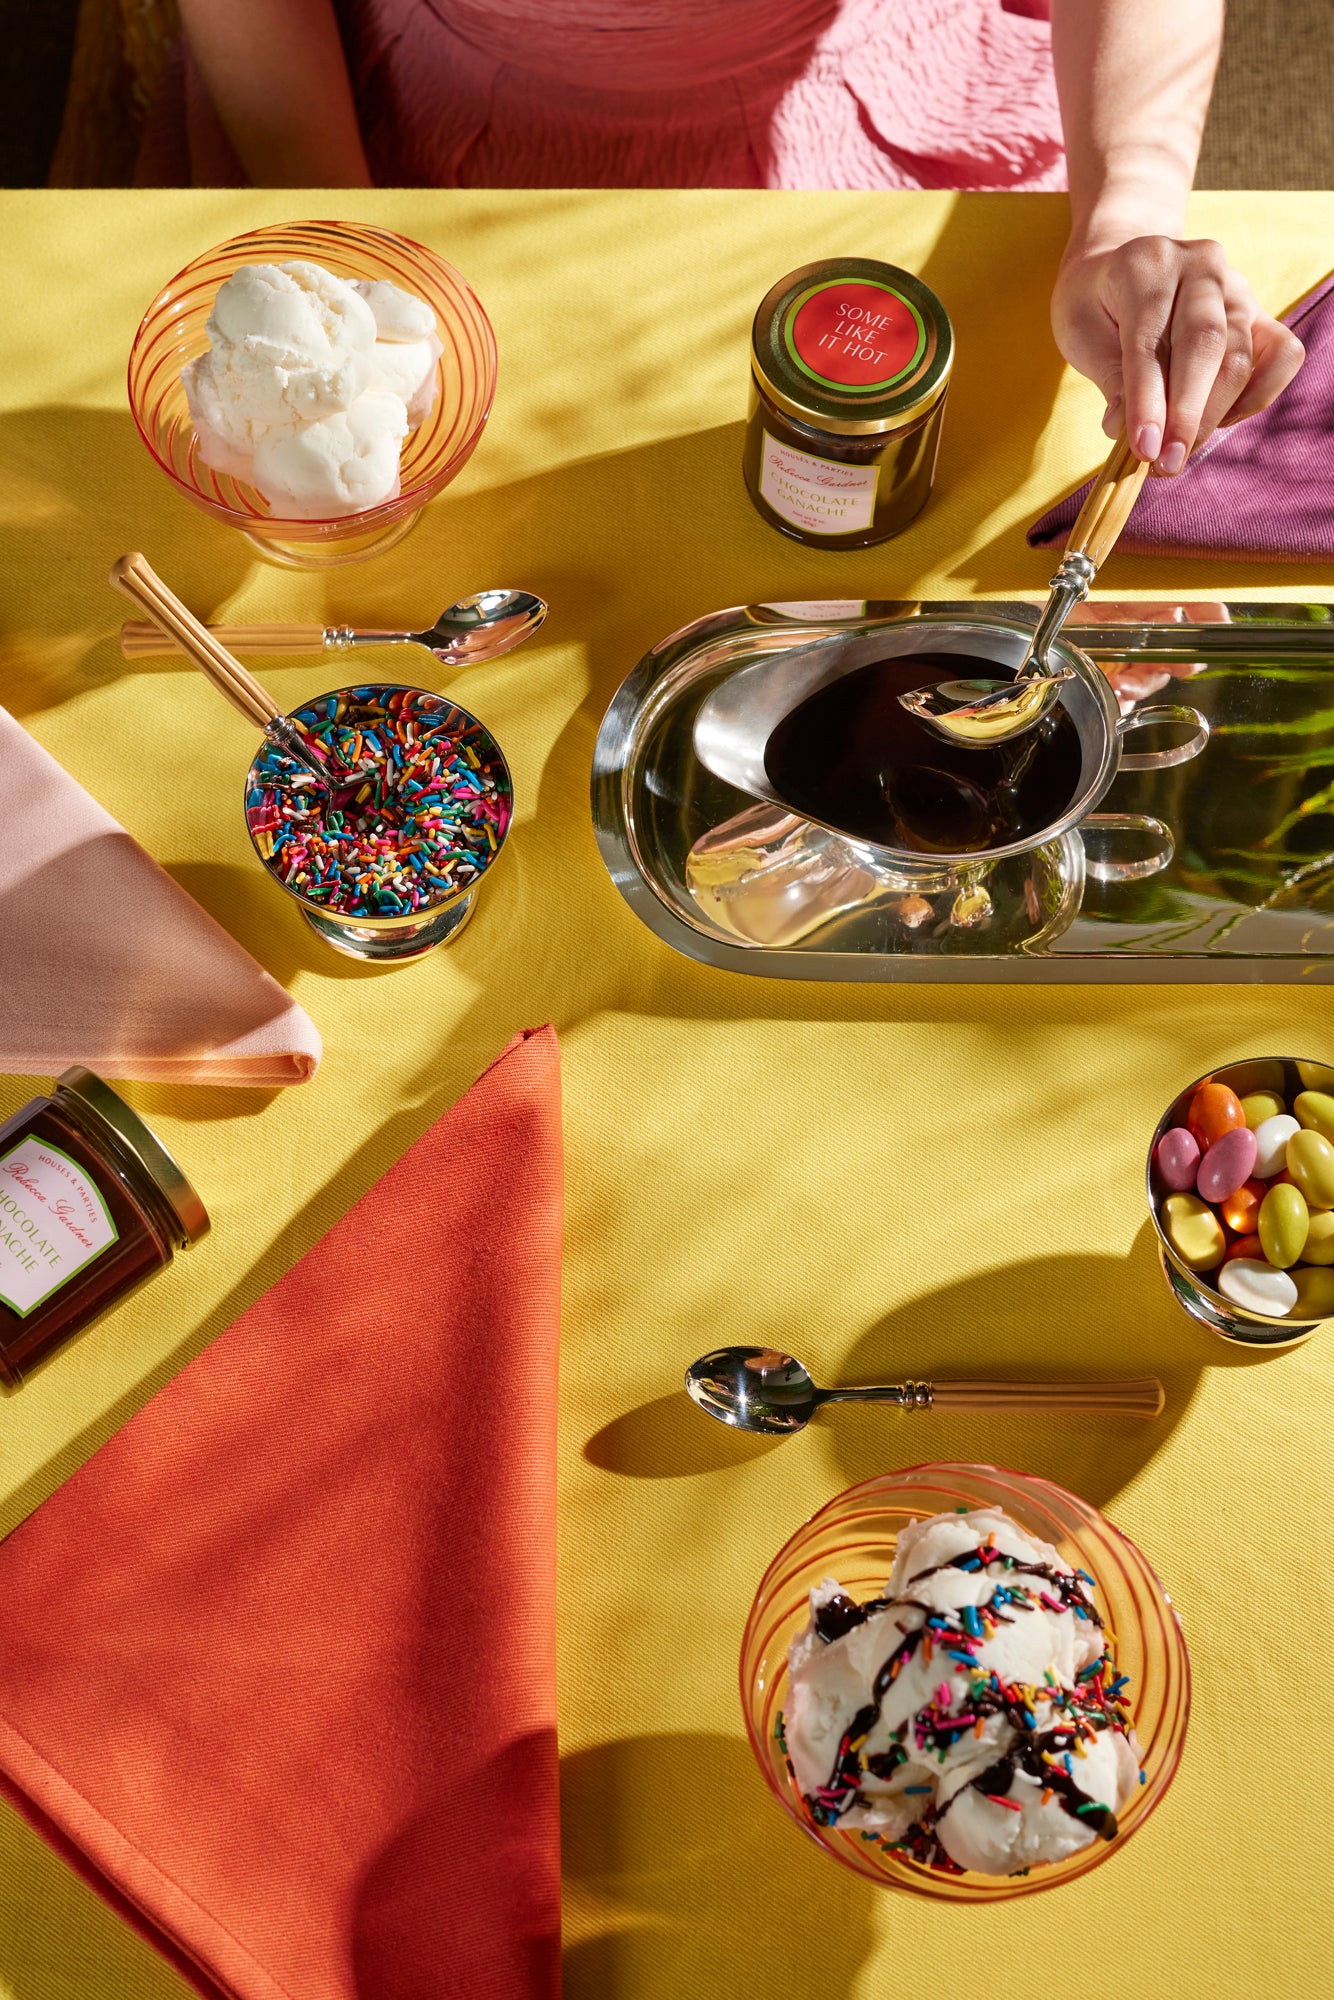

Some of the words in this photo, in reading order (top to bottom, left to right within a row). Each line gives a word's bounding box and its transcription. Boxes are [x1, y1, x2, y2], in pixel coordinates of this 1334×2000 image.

[834, 320, 880, 345] LIKE
[836, 303, 893, 331] SOME
[818, 334, 842, 350] IT
[842, 341, 888, 365] HOT
[768, 455, 811, 483] Rebecca
[815, 475, 868, 488] Gardner
[820, 464, 854, 477] PARTIES
[770, 471, 859, 507] CHOCOLATE
[777, 488, 848, 517] GANACHE
[2, 1161, 47, 1204] Rebecca
[48, 1198, 93, 1249] Gardner
[38, 1154, 71, 1179] HOUSES
[77, 1186, 98, 1224] PARTIES
[0, 1189, 63, 1269] HOCOLATE
